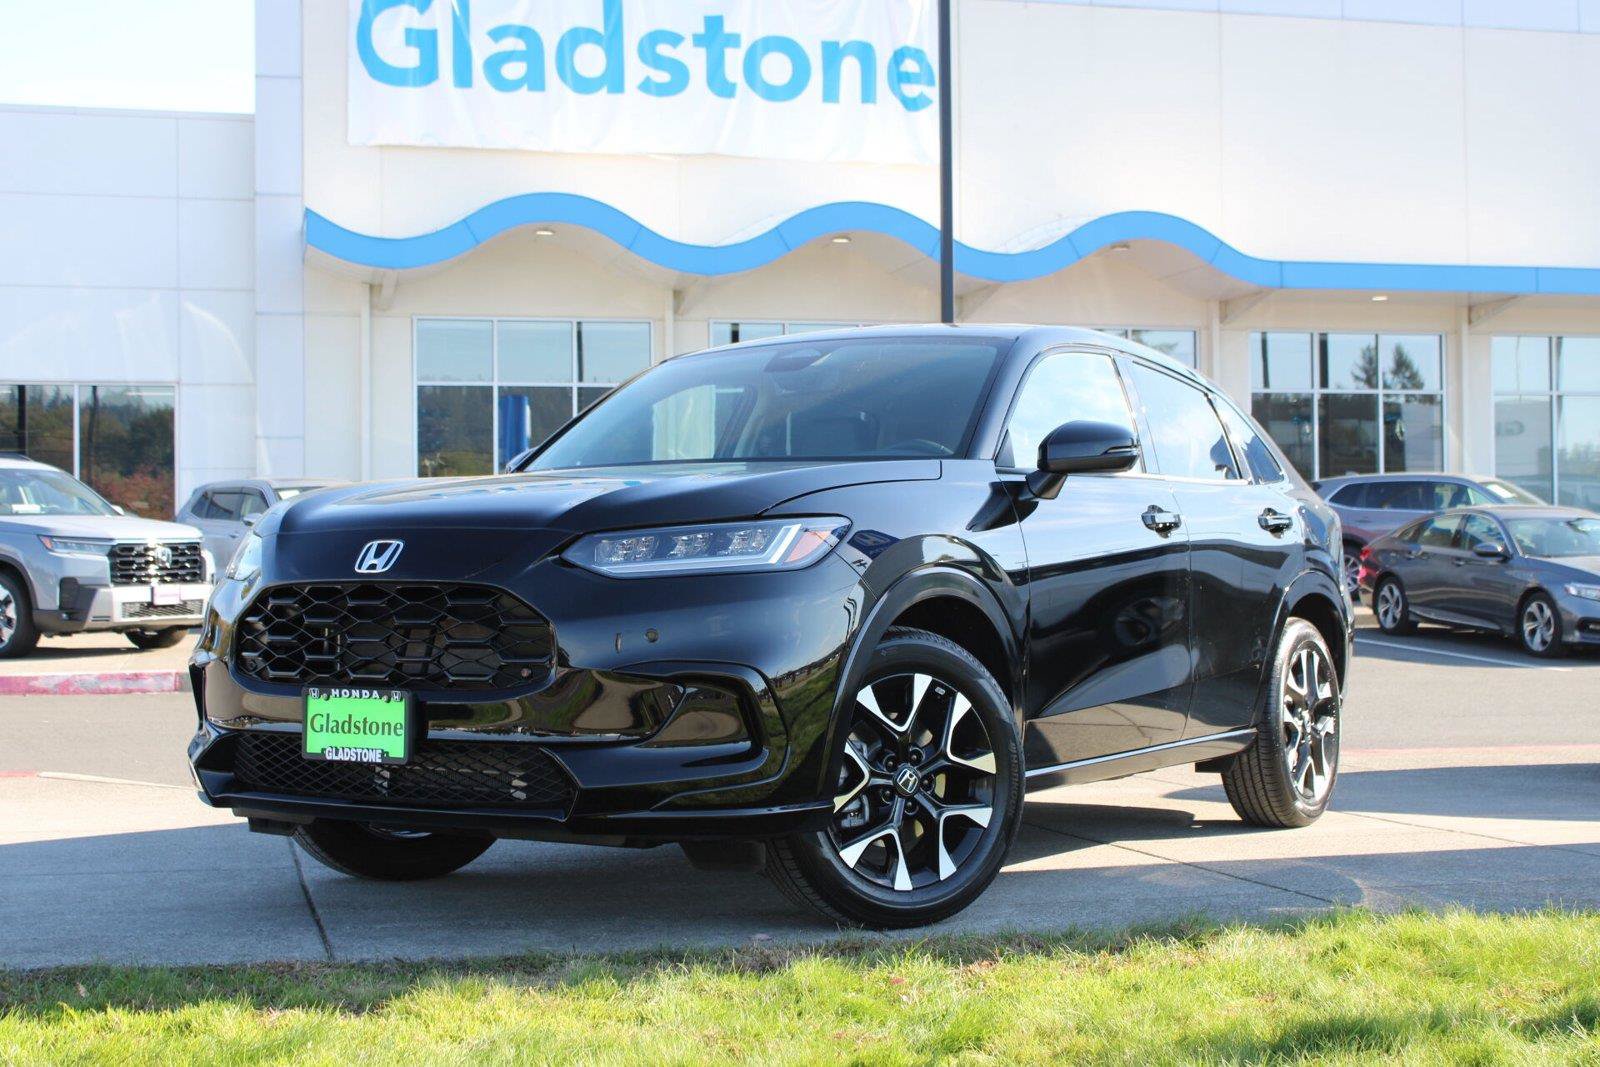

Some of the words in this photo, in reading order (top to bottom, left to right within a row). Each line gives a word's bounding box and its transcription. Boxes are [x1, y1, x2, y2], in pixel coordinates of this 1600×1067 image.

[356, 0, 936, 111] Gladstone
[331, 688, 381, 699] HONDA
[310, 713, 404, 737] Gladstone
[325, 747, 382, 762] GLADSTONE
